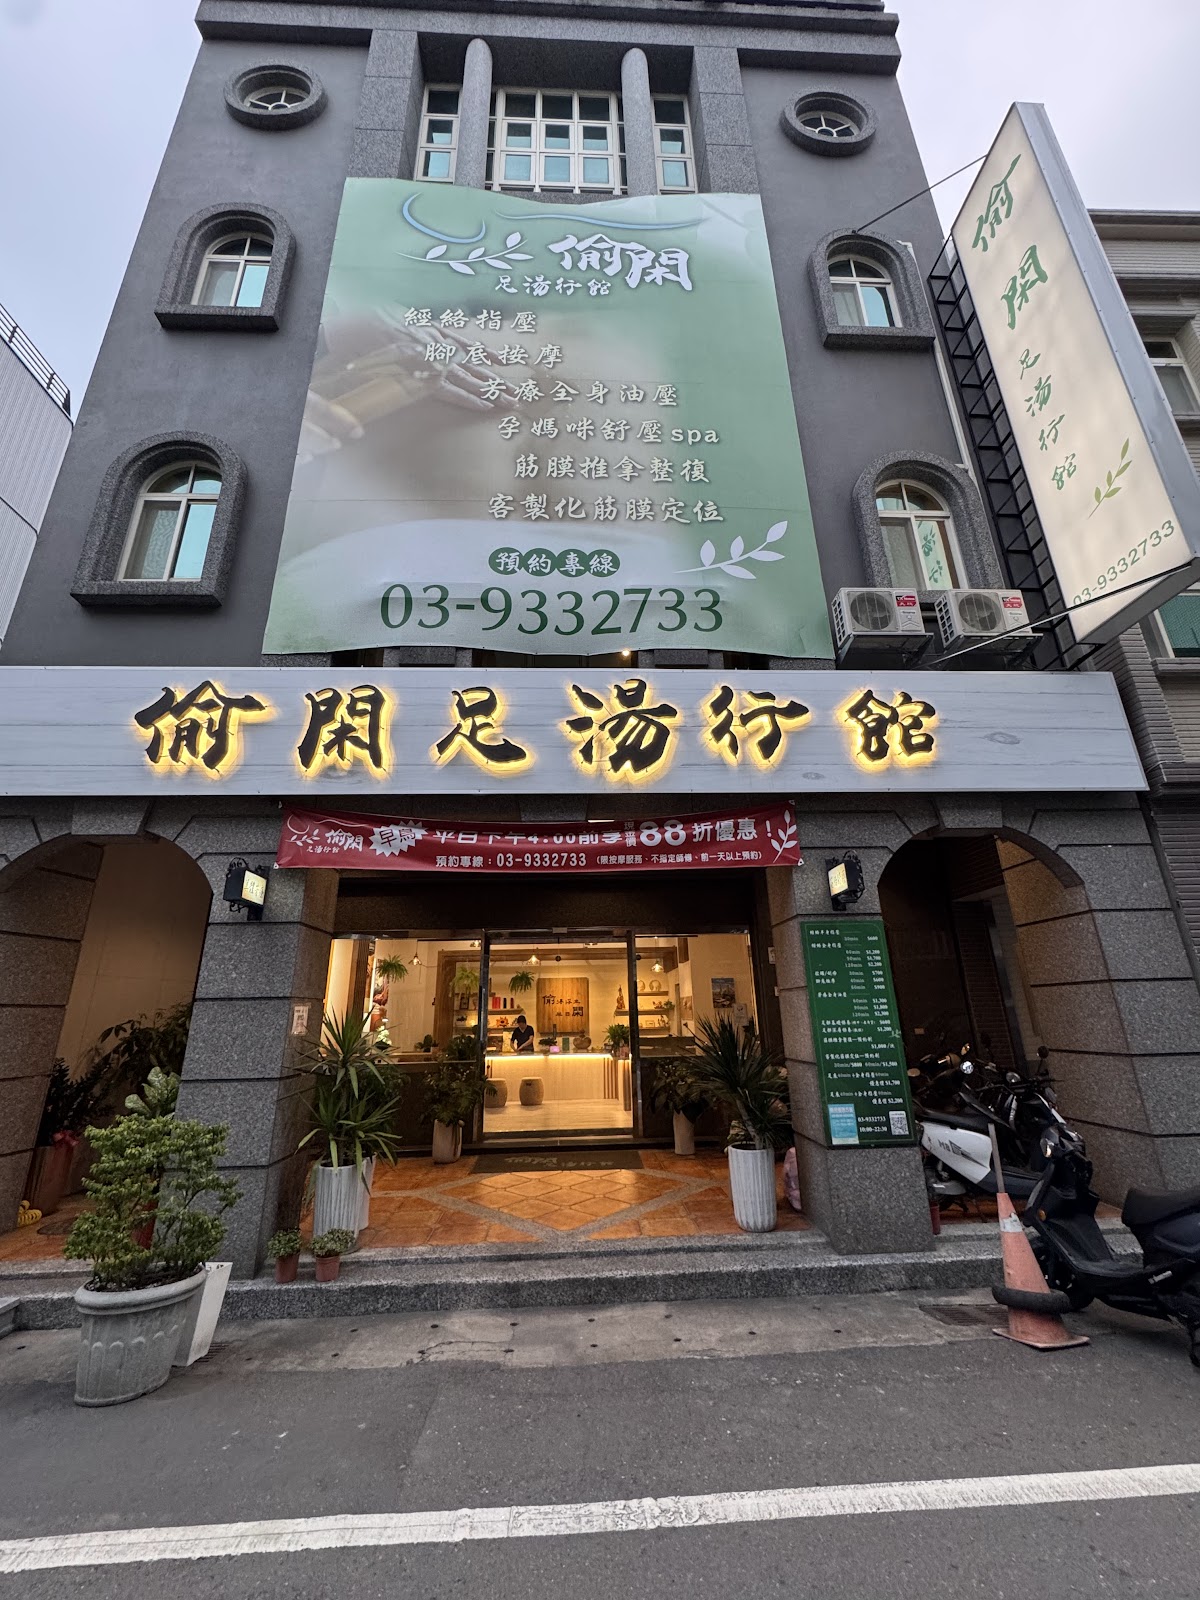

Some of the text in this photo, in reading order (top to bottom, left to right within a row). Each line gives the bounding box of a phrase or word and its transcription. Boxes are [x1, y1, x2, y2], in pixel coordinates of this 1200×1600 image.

[548, 233, 693, 291] 偷閑
[495, 275, 611, 296] 足湯行館
[404, 307, 537, 333] 經絡指壓
[424, 343, 563, 368] 腳底按摩
[479, 378, 678, 406] 芳療全身油壓
[498, 415, 720, 445] 孕媽咪舒壓spa
[514, 453, 710, 483] 筋膜推拿整復
[488, 493, 723, 524] 客製化筋膜定位
[496, 551, 618, 575] 預約專線
[1073, 520, 1175, 605] 03-9332733
[380, 583, 723, 635] 03-9332733
[134, 678, 936, 773] 偷閑足湯行館
[379, 828, 416, 847] 早鳥
